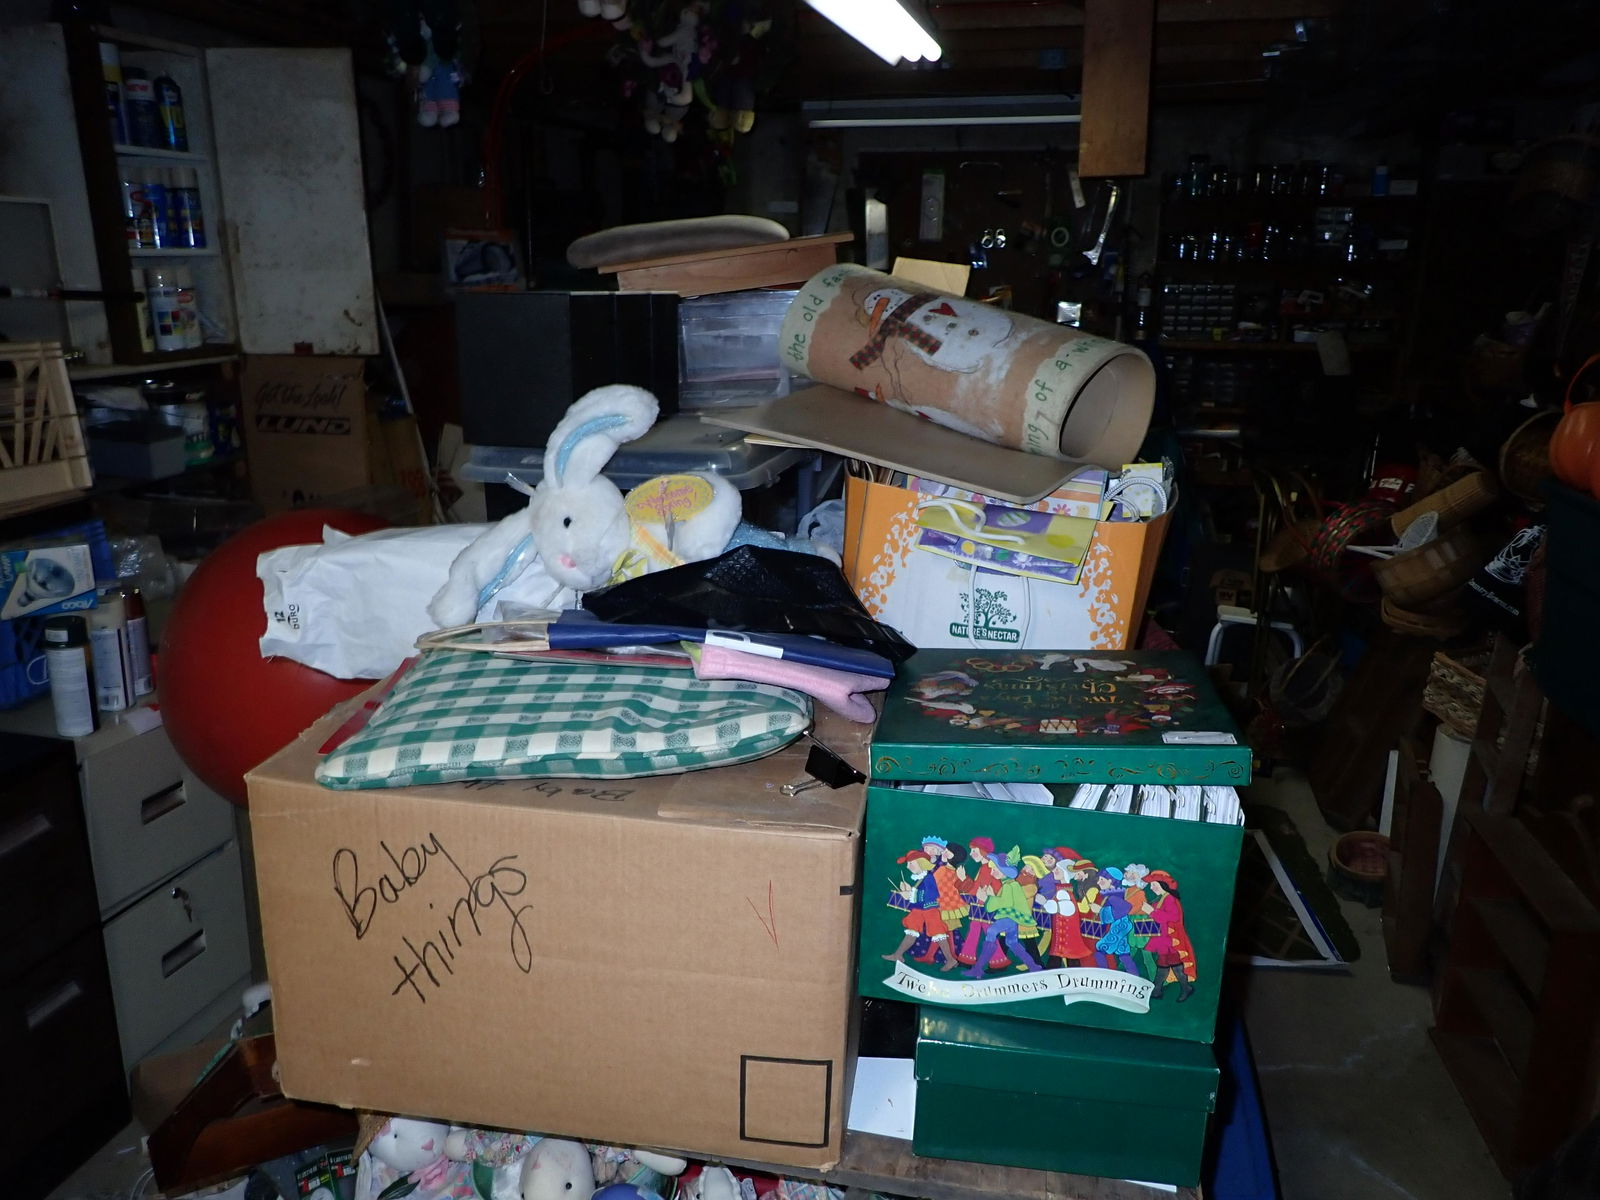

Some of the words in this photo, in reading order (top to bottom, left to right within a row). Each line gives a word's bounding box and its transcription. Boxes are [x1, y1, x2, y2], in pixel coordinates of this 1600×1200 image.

[787, 334, 807, 363] the
[804, 296, 826, 323] old
[1034, 378, 1054, 402] of
[256, 415, 351, 433] LUND
[274, 611, 286, 623] 12
[288, 604, 301, 630] DURO
[952, 624, 987, 637] NATRE'S
[987, 630, 1017, 642] NECTAR
[333, 832, 473, 940] Baby
[392, 854, 533, 1004] things
[896, 970, 951, 998] Twe
[961, 976, 1049, 999] Drummers
[1056, 972, 1152, 1000] Drumming
